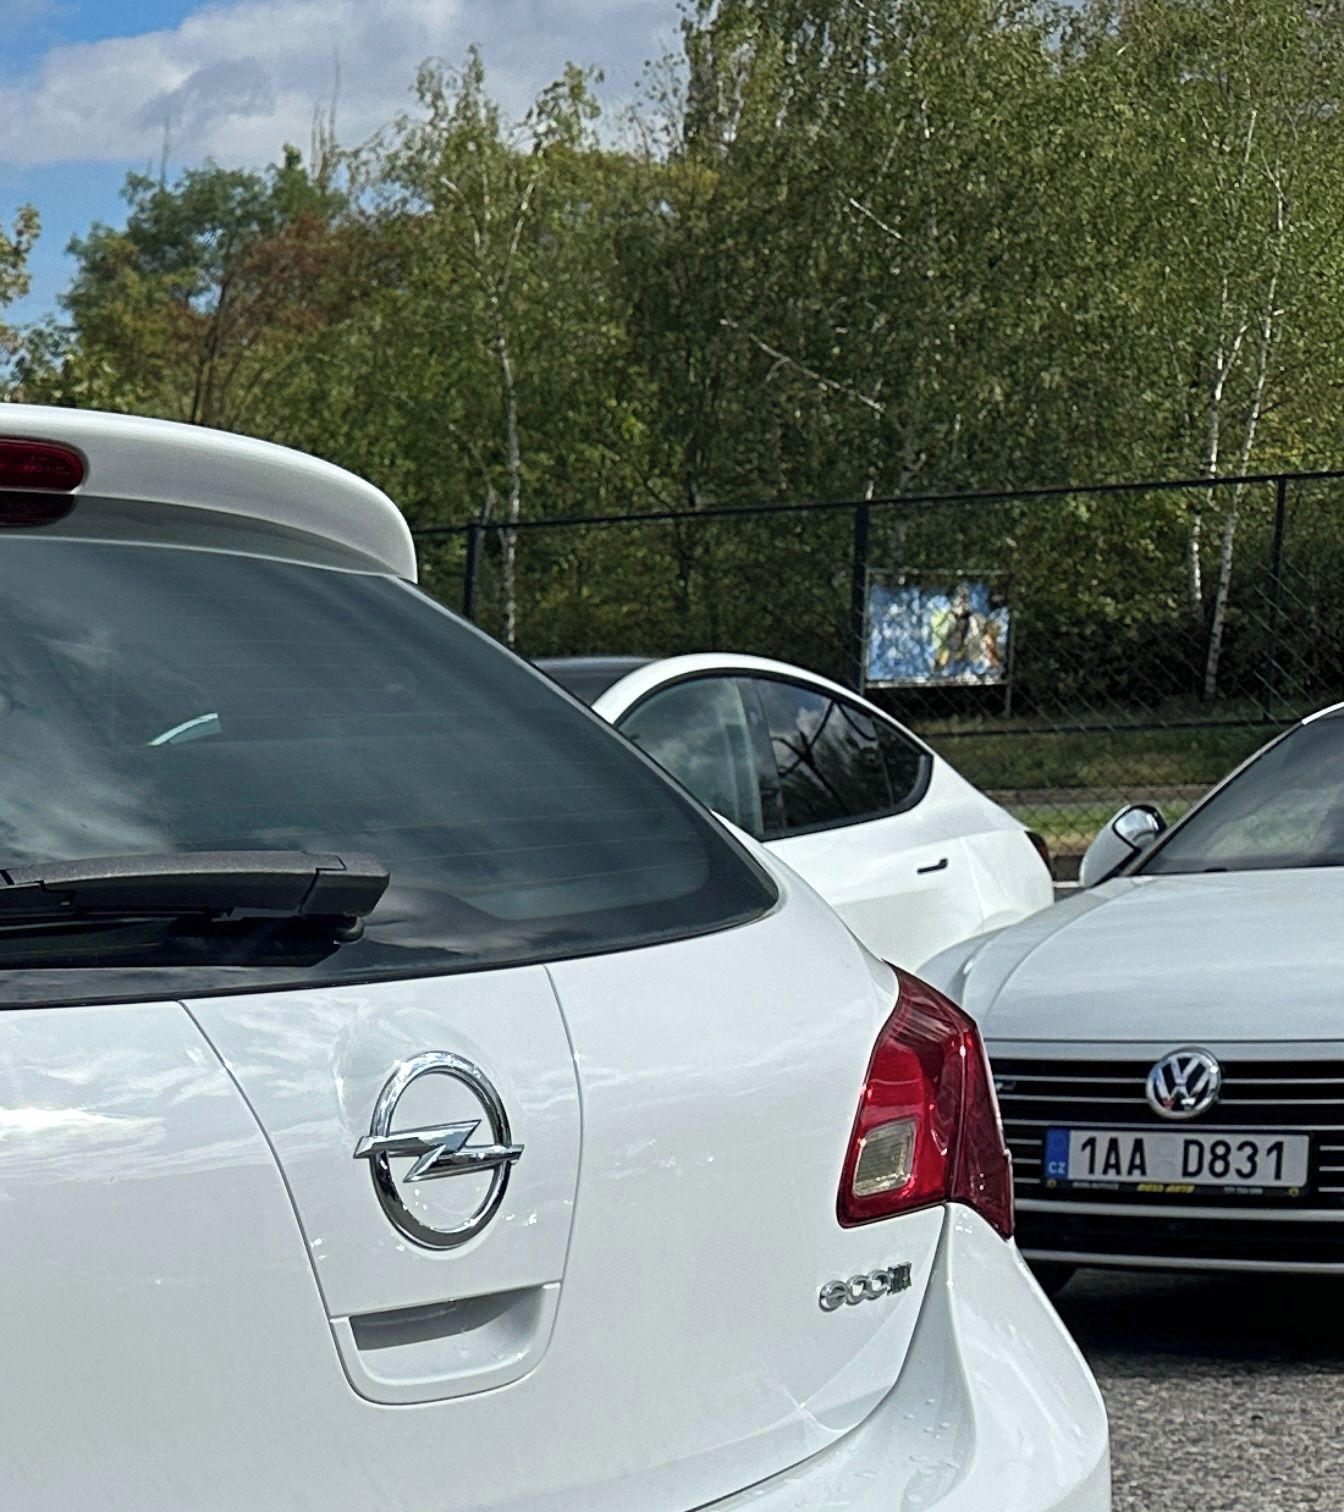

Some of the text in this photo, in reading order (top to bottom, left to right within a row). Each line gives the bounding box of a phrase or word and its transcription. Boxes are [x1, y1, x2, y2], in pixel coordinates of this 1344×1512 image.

[1047, 1161, 1066, 1174] CZ
[1080, 1136, 1284, 1180] 1AA D831
